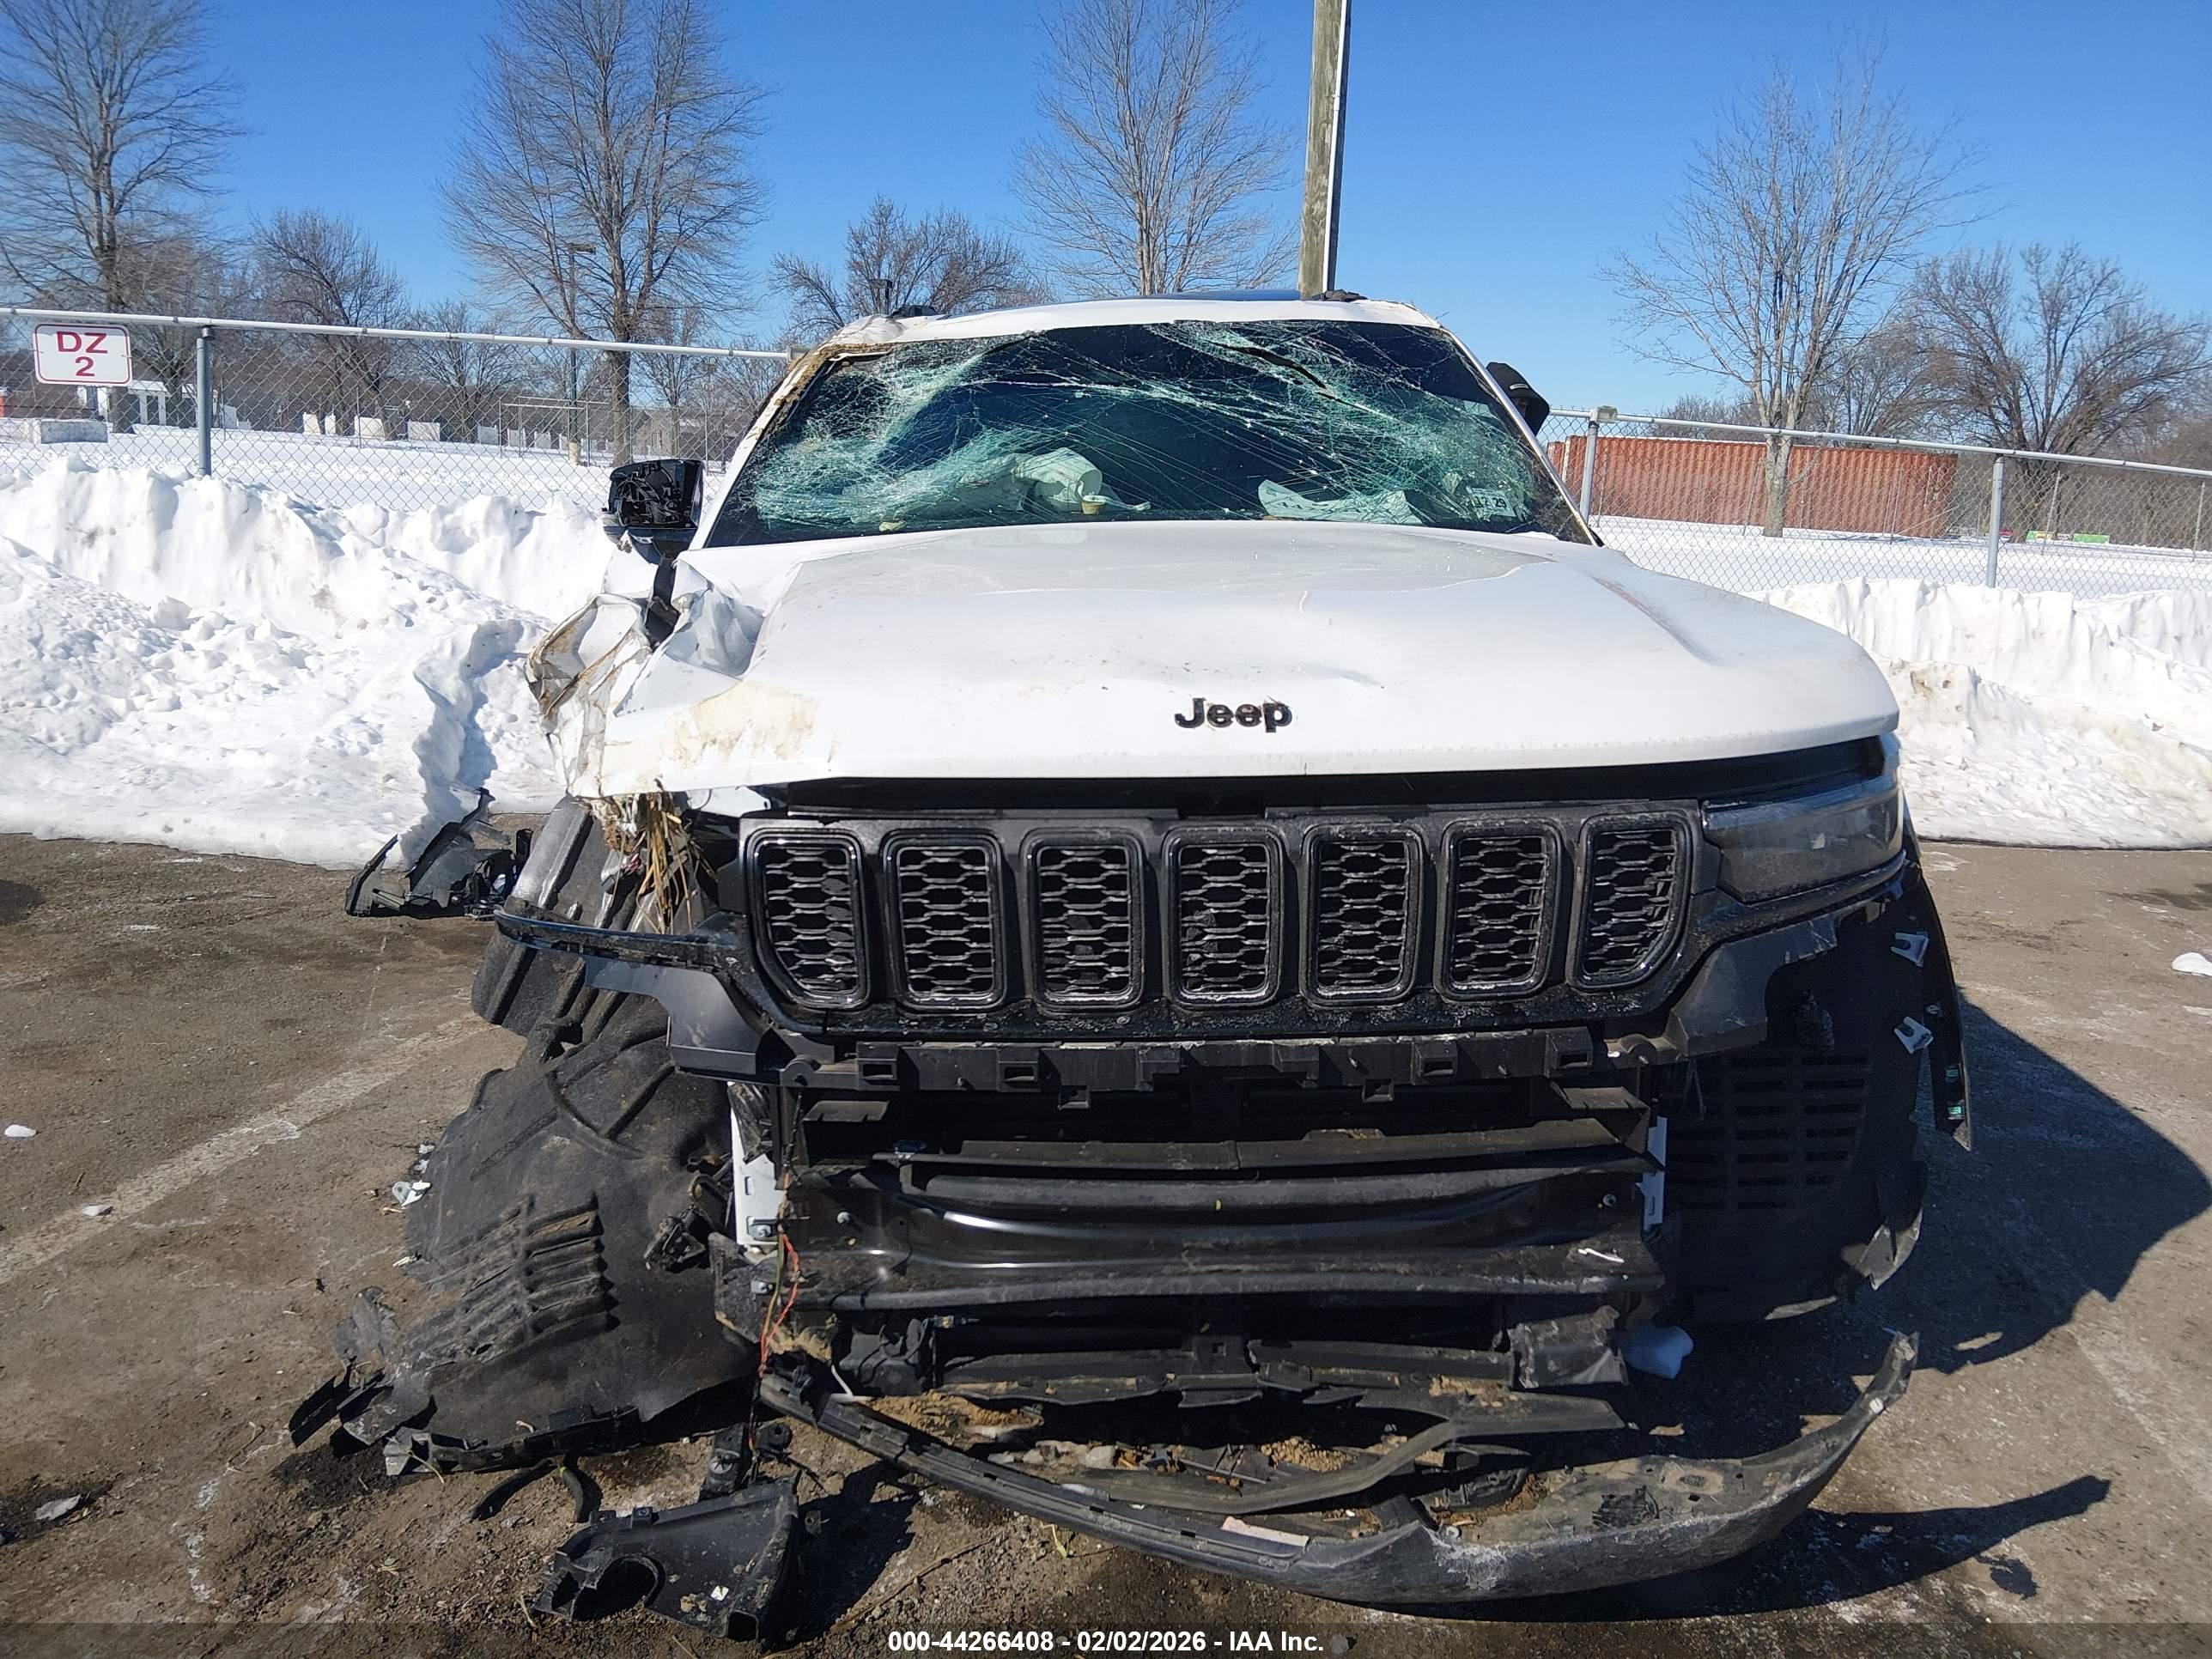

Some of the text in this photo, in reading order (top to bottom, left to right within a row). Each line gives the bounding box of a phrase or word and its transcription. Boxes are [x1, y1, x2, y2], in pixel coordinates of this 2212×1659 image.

[57, 331, 108, 354] DZ
[75, 356, 95, 377] 2
[1492, 497, 1508, 508] 29
[1174, 697, 1293, 733] Jeep
